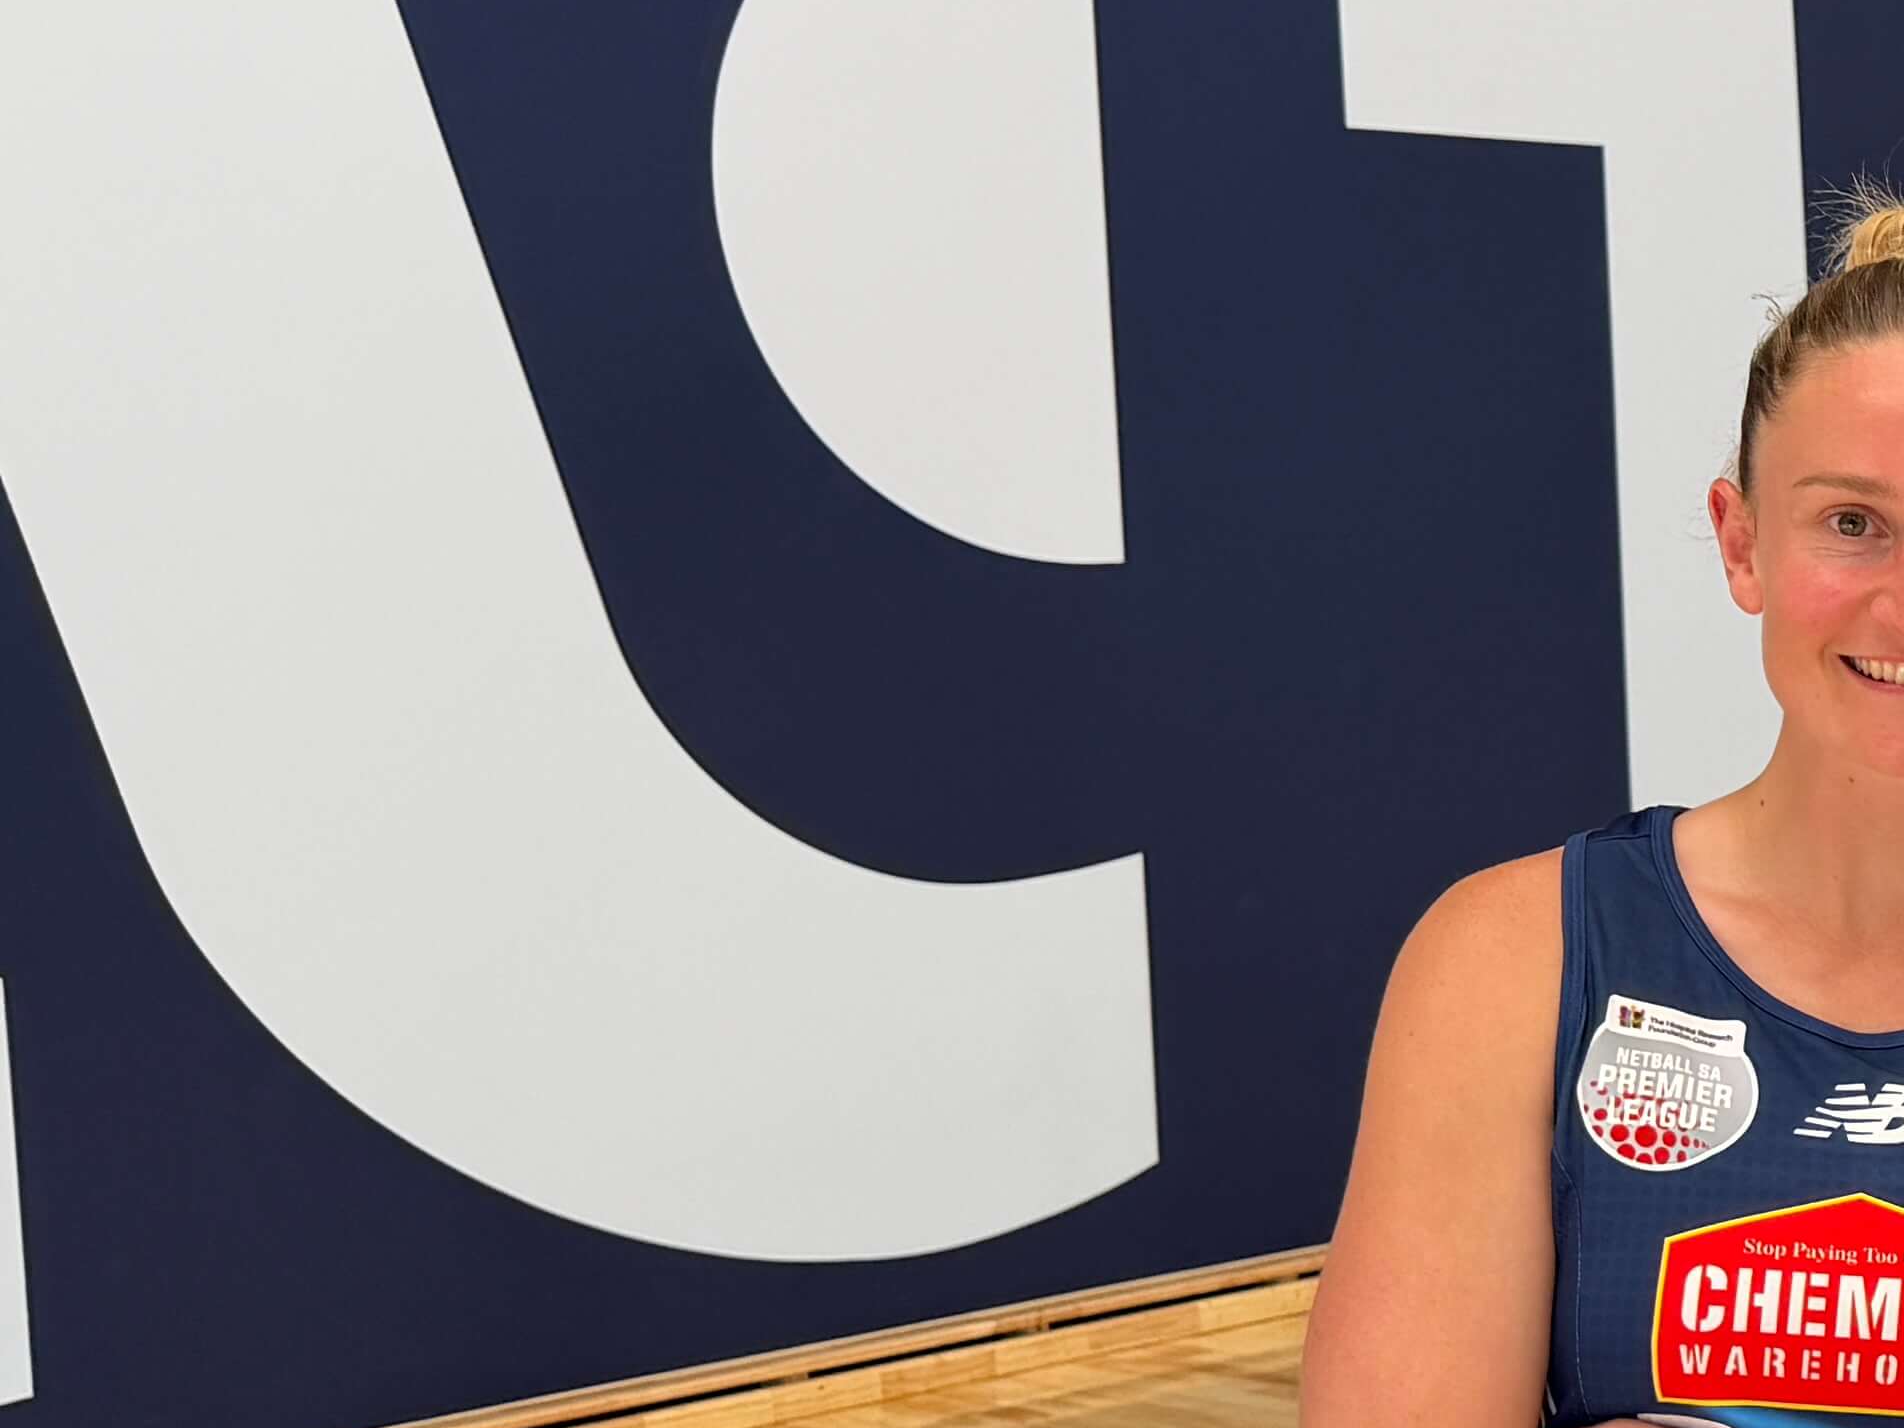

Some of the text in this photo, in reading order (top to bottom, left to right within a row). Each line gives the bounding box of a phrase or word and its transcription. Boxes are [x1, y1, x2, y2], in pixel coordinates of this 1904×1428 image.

[1616, 1047, 1721, 1082] NETBALL SA
[1597, 1063, 1733, 1109] PREMIER
[1607, 1095, 1718, 1132] LEAGUE
[1743, 1237, 1788, 1259] Stop
[1791, 1241, 1858, 1266] Paying
[1863, 1246, 1899, 1266] Too
